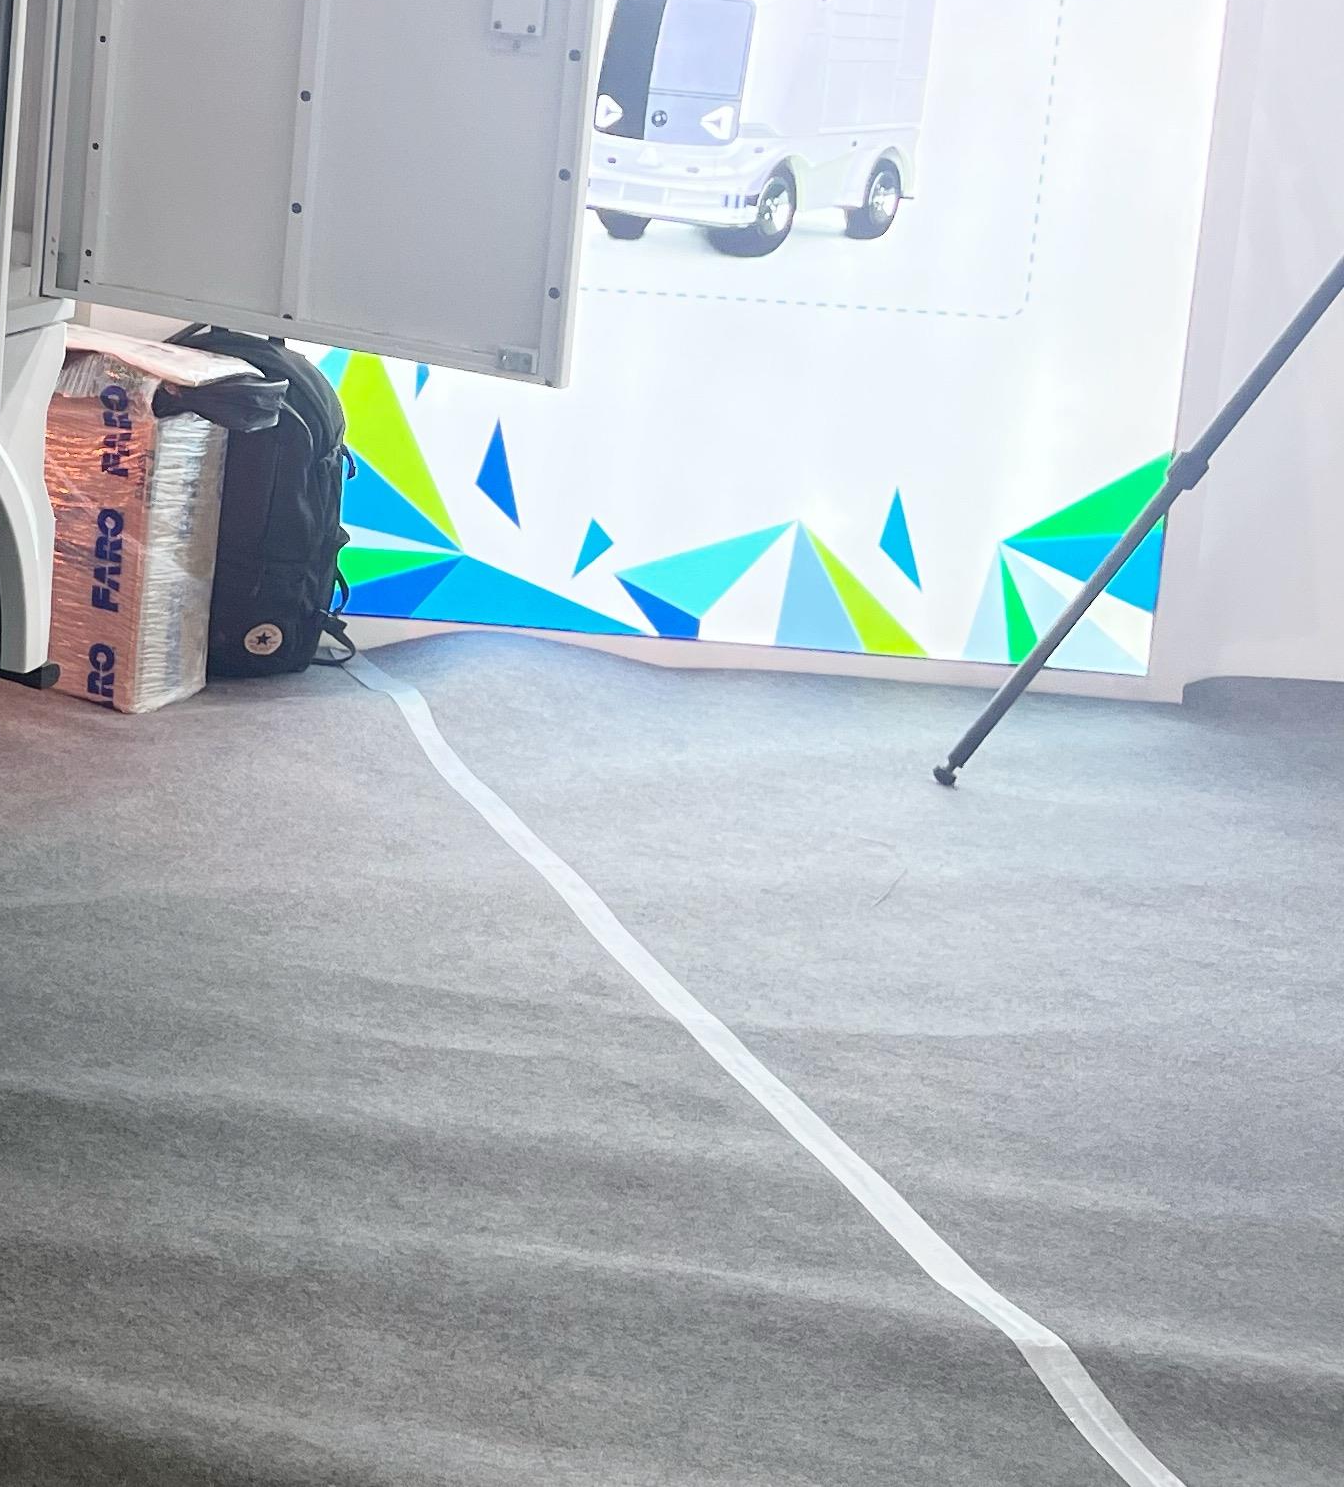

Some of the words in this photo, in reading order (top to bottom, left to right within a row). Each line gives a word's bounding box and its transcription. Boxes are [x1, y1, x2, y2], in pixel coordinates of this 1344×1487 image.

[100, 385, 129, 477] FARO
[92, 508, 124, 612] FARO
[88, 642, 115, 708] RO
